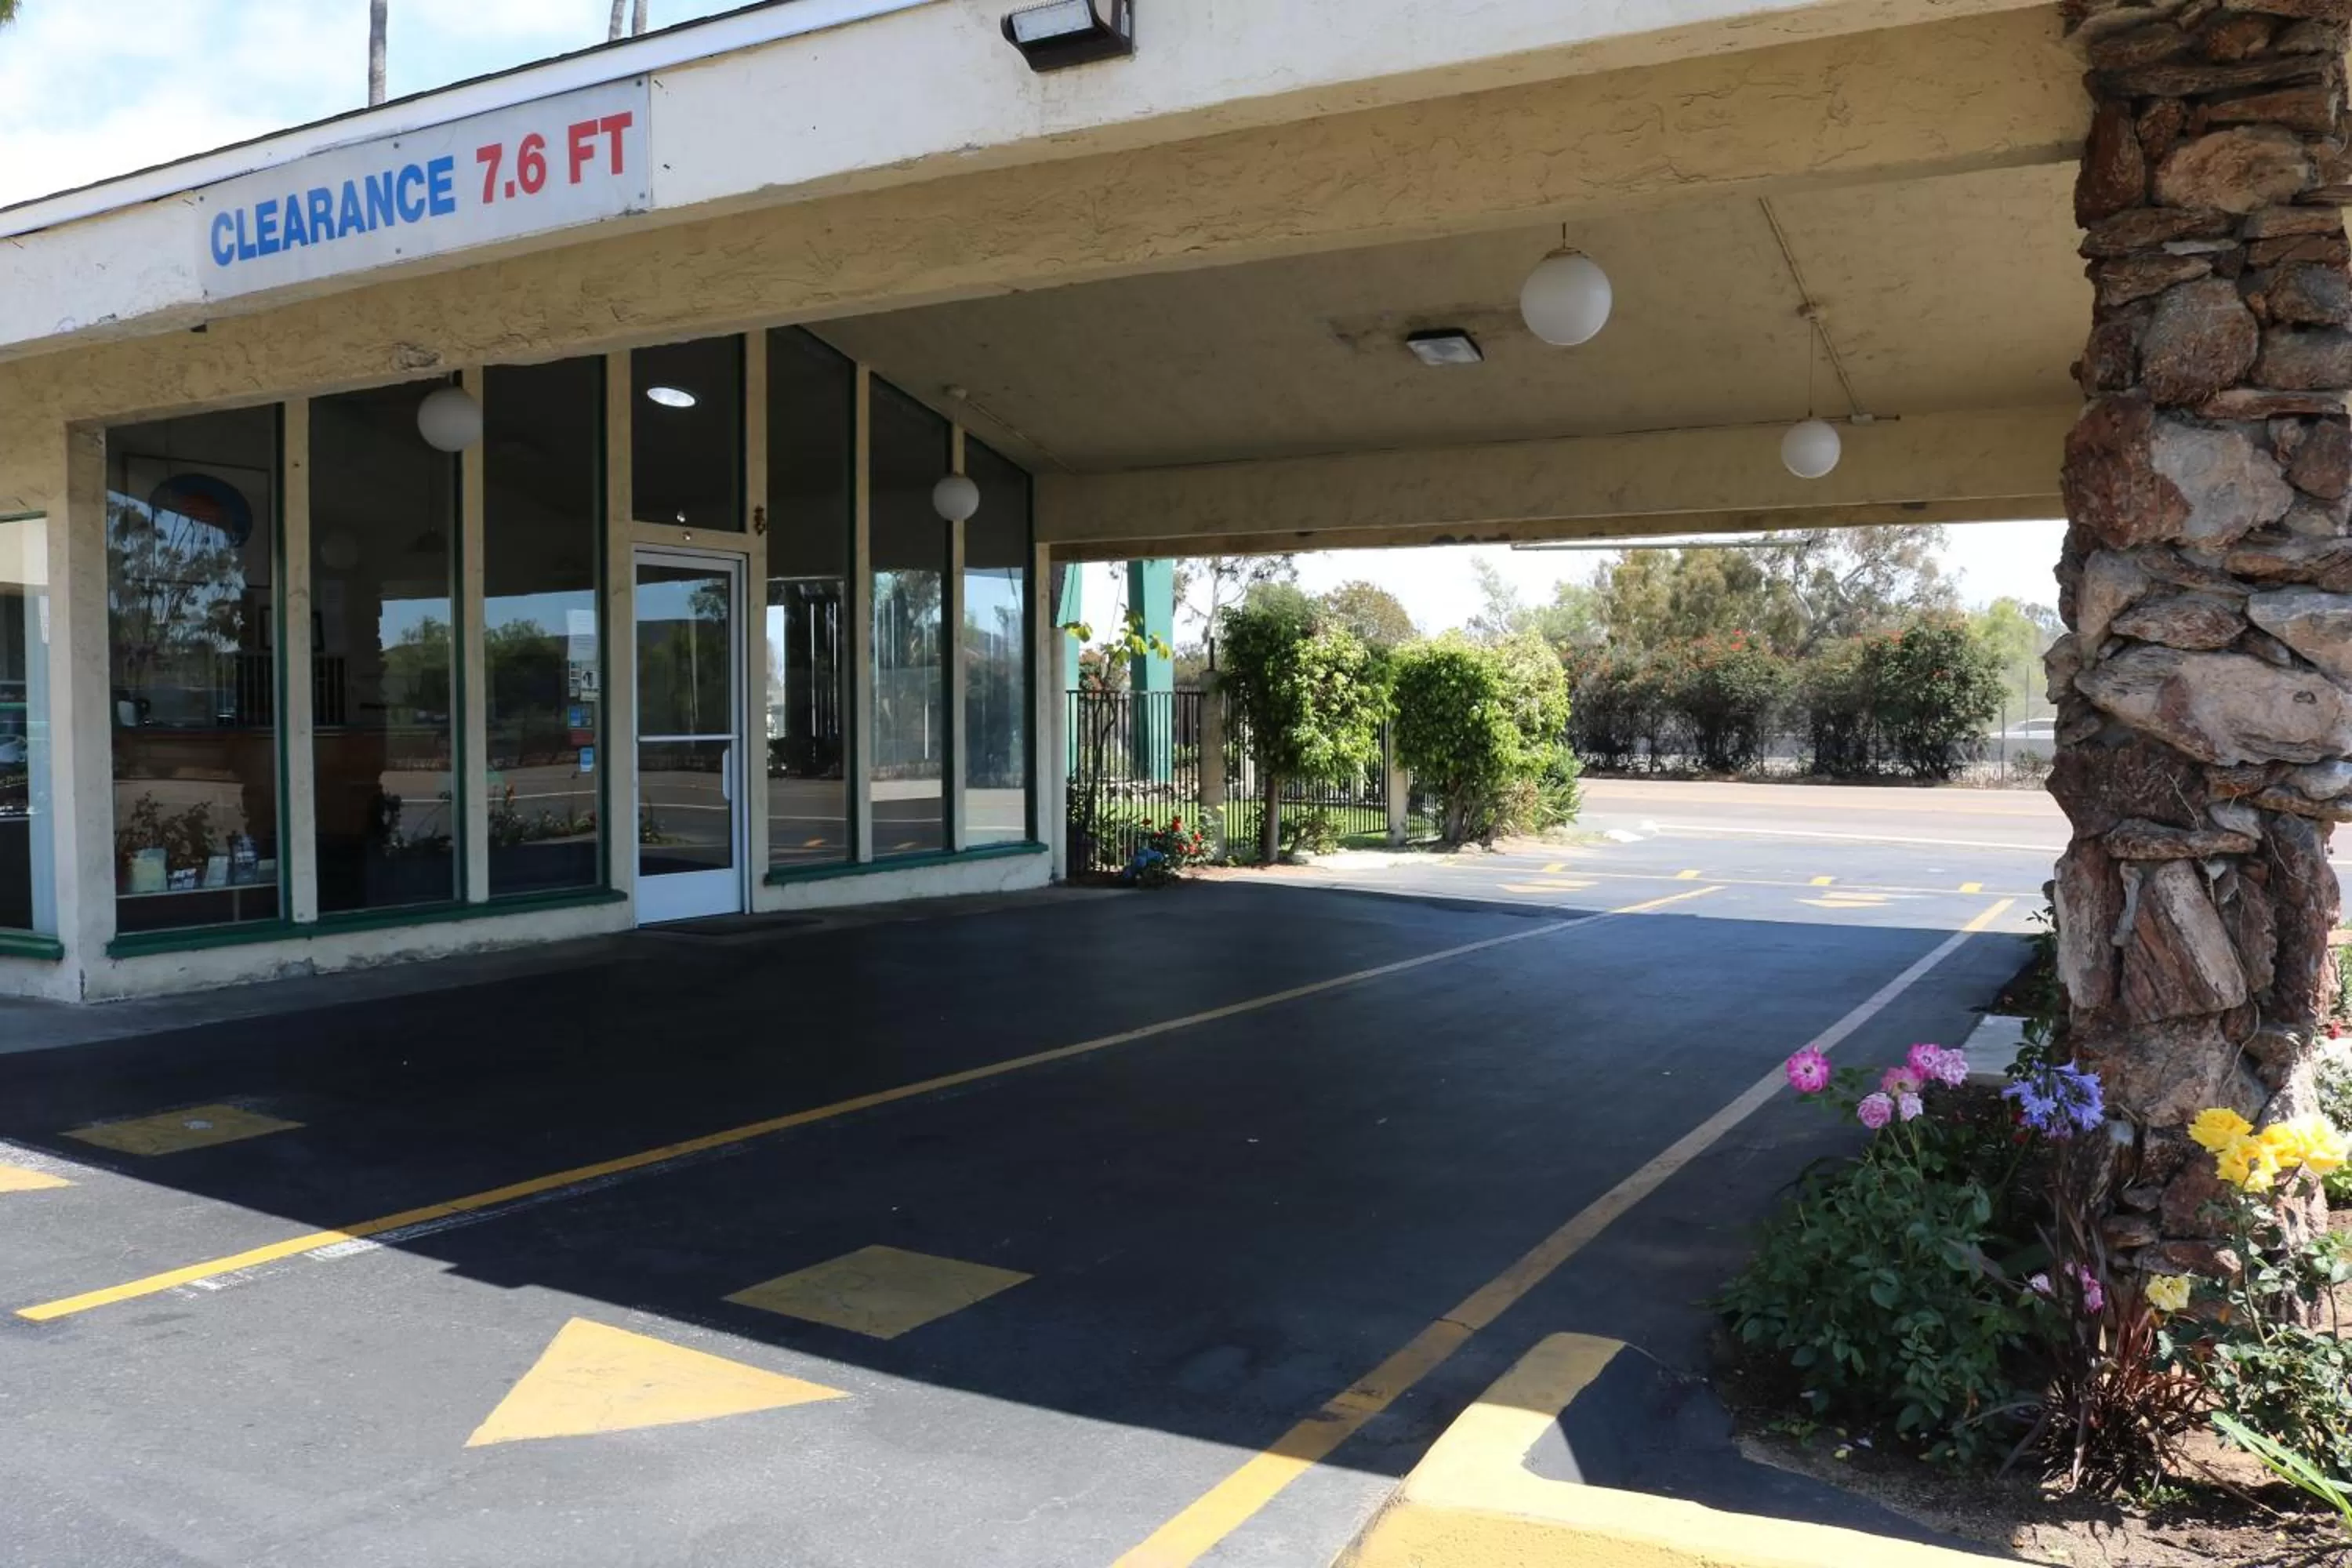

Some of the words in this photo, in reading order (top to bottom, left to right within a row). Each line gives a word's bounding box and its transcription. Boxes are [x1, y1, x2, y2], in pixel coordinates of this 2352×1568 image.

[211, 155, 456, 267] CLEARANCE
[476, 133, 546, 203] 7.6
[568, 111, 632, 184] FT
